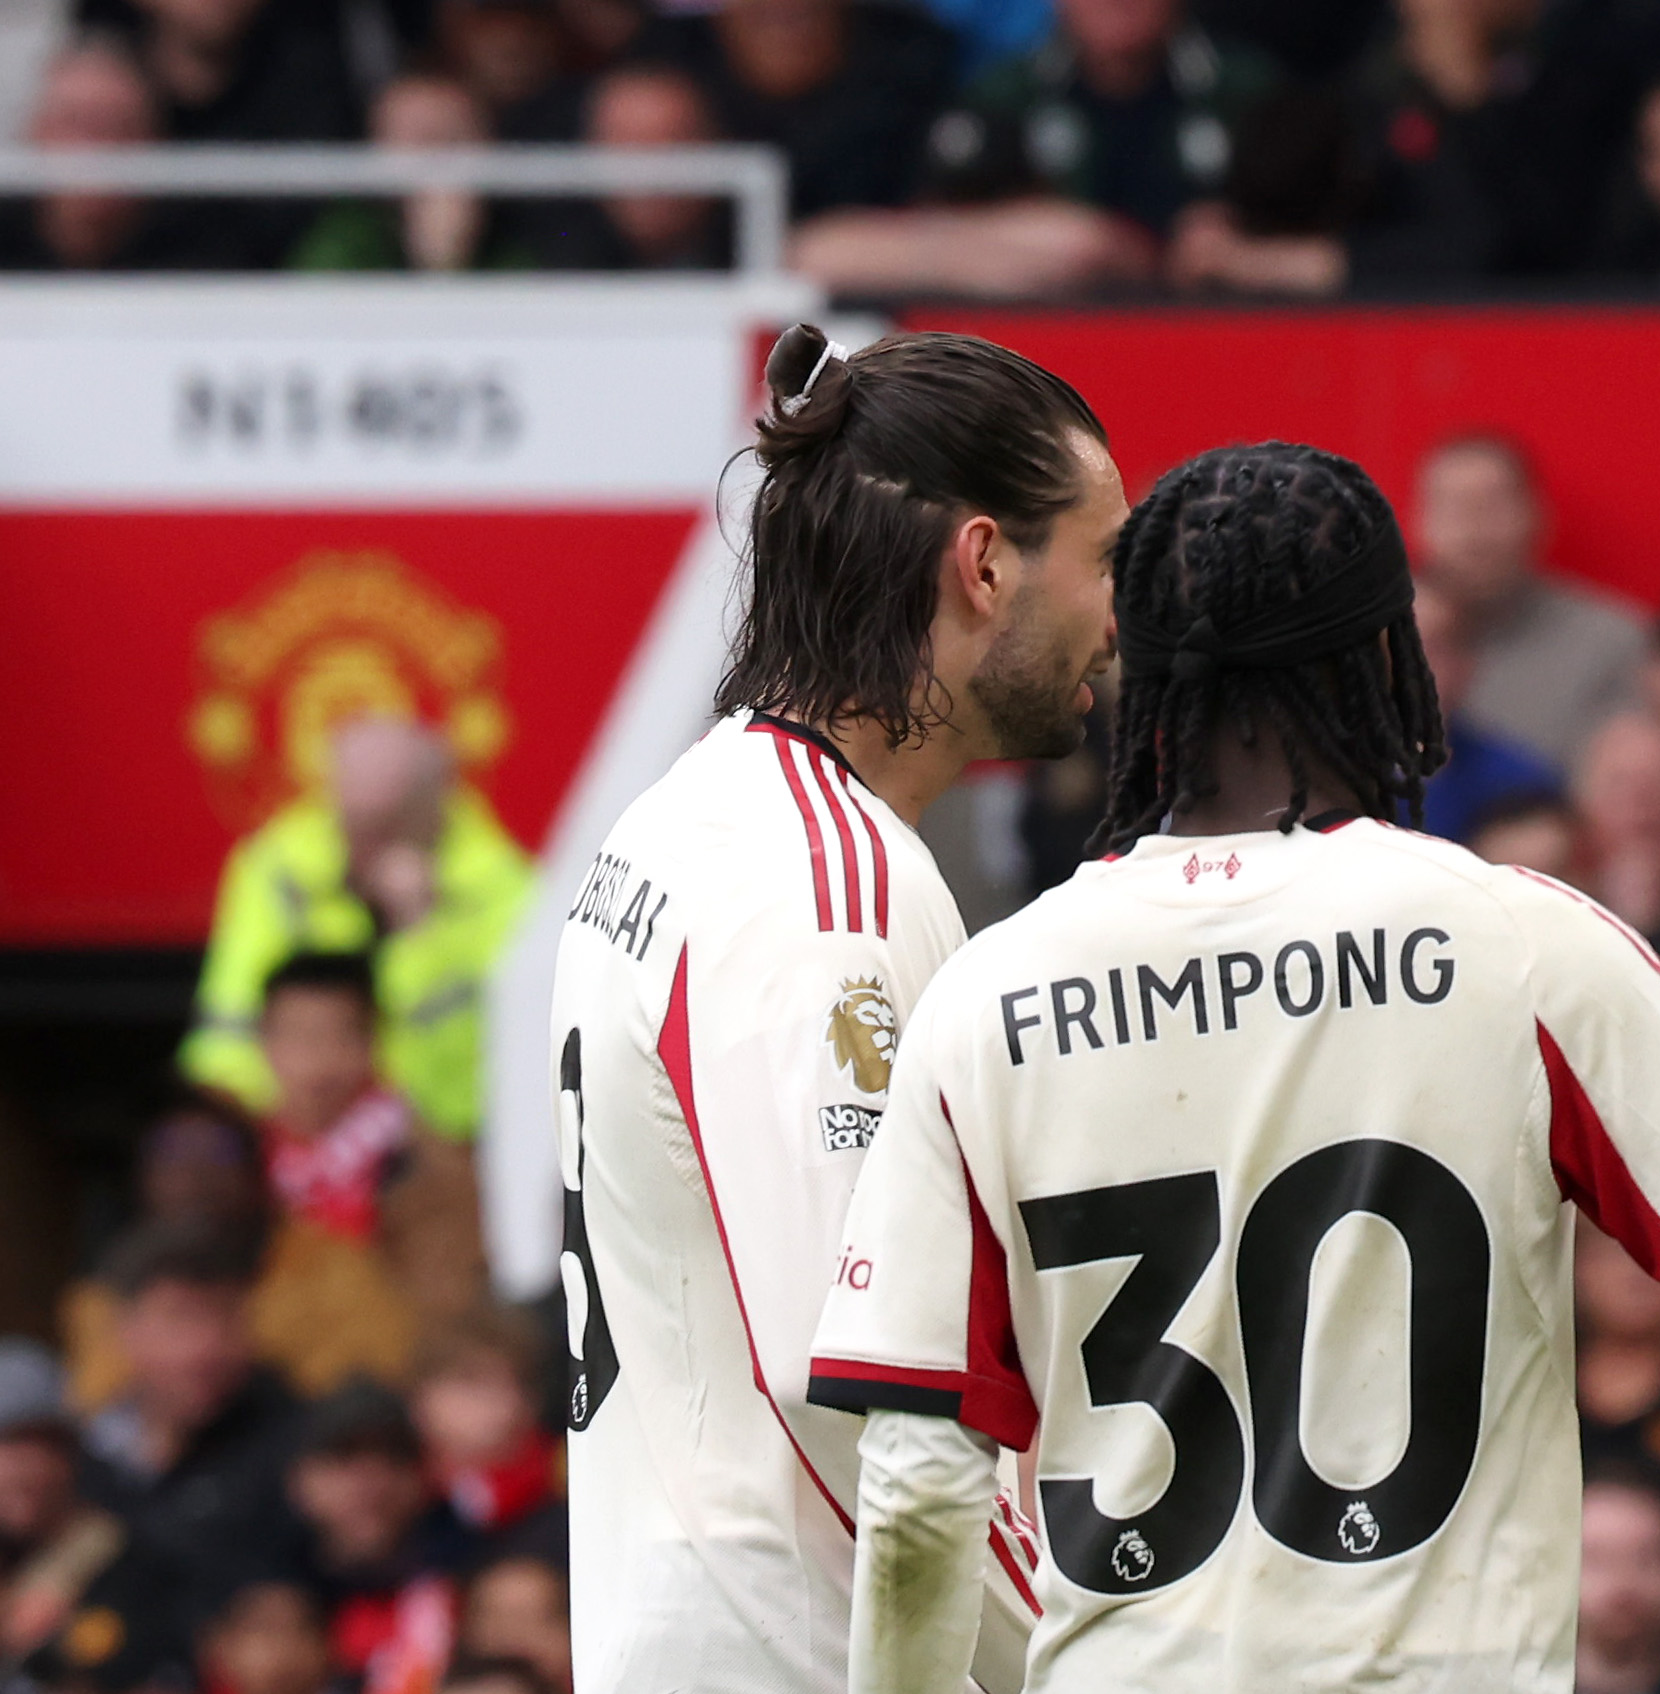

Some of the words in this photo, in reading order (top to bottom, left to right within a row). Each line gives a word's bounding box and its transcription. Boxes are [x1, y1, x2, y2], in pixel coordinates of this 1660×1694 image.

[1000, 926, 1456, 1067] FRIMPONG
[820, 1105, 858, 1130] No
[1016, 1136, 1492, 1596] 30
